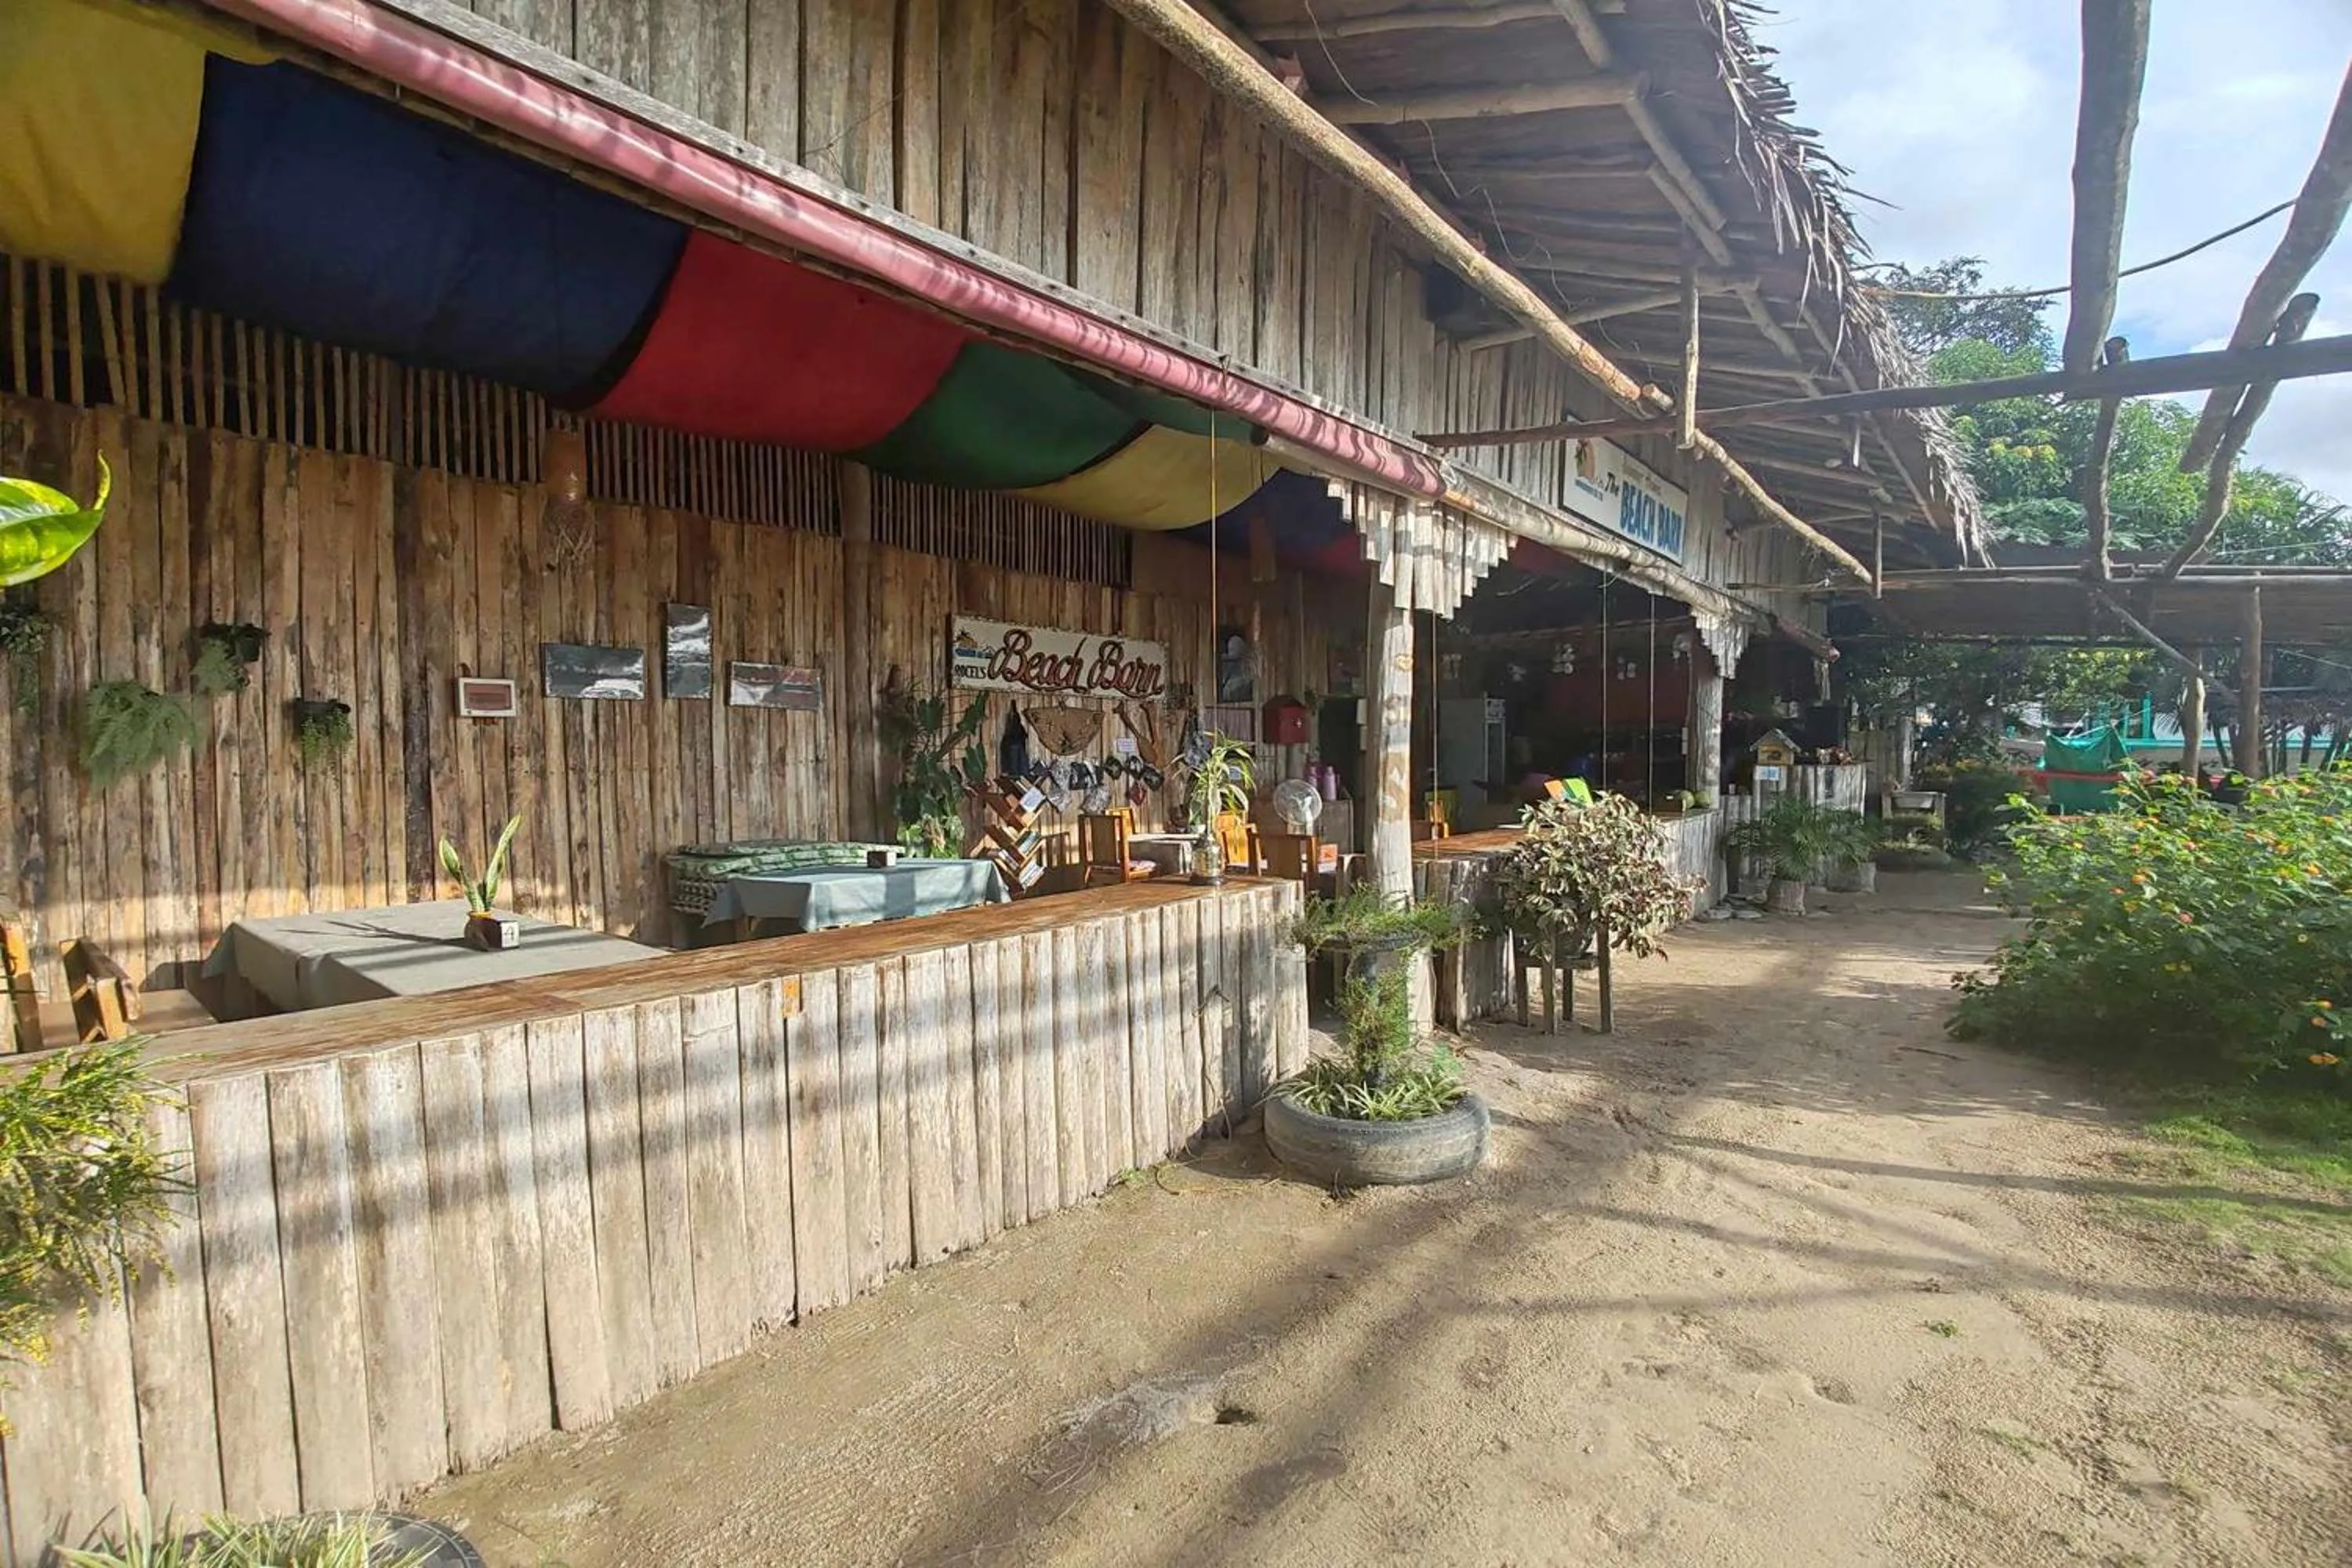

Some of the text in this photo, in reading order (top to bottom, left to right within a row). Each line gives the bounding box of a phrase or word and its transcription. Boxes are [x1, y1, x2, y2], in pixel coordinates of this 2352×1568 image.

[1621, 480, 1657, 544] BEACH
[1657, 502, 1682, 557] BARN
[988, 629, 1163, 699] Beach Barn
[504, 926, 514, 941] 4
